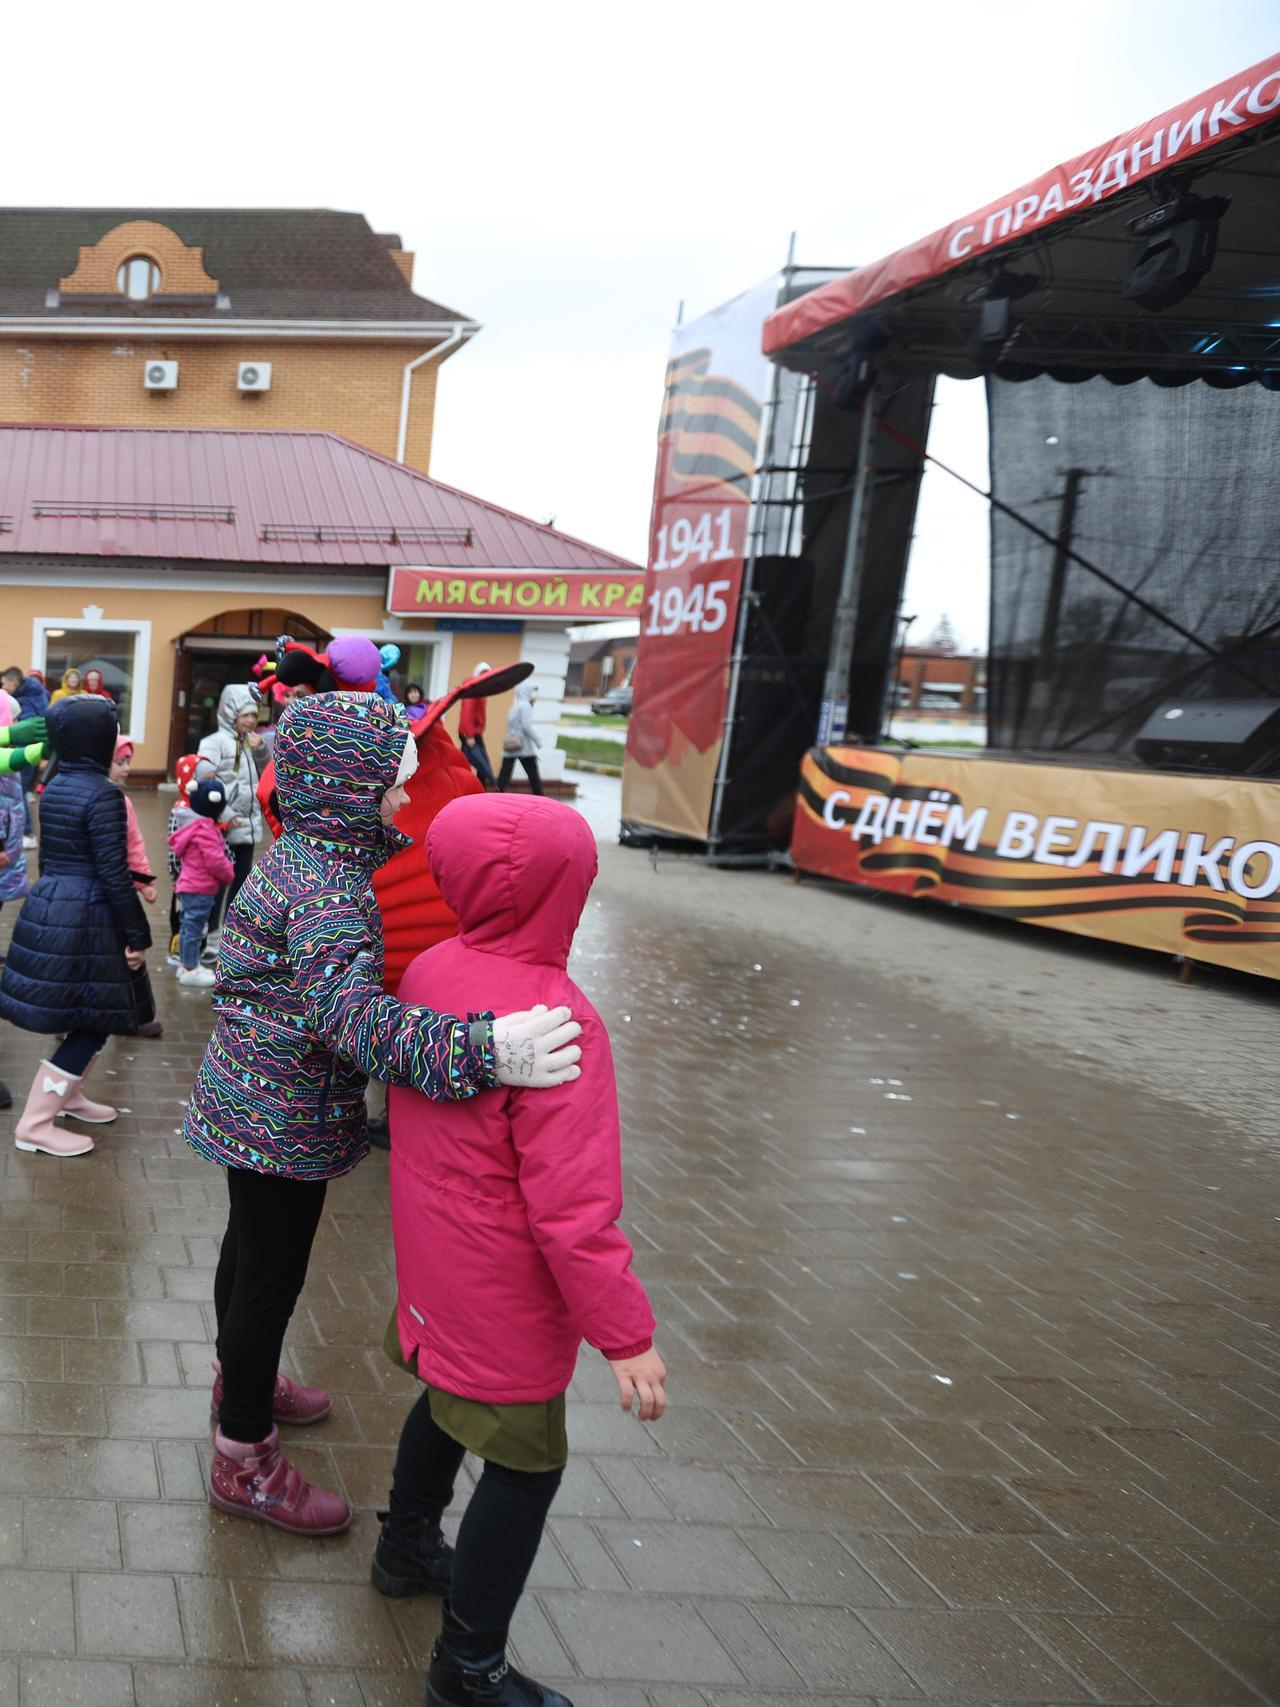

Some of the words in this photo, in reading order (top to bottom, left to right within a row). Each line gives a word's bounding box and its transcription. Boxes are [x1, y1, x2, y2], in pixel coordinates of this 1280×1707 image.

[948, 226, 977, 260] С
[652, 507, 736, 571] 1941
[416, 577, 568, 607] МЯСНОЙ
[580, 582, 645, 608] КРА
[646, 579, 731, 637] 1945
[823, 790, 851, 830] С
[852, 791, 988, 852] ДНЁМ
